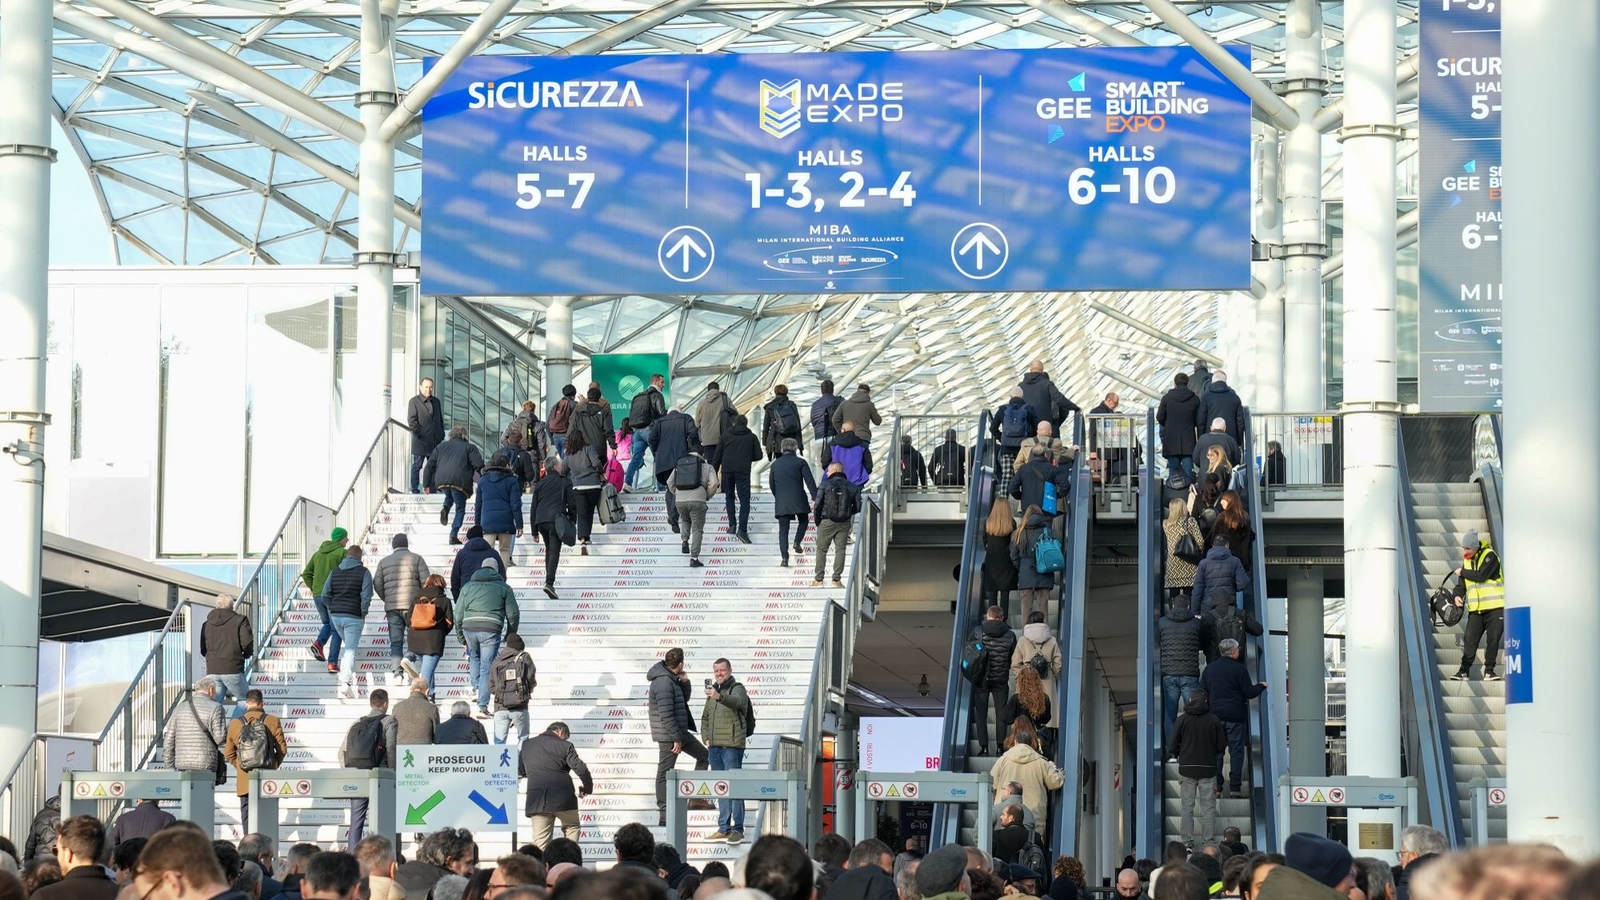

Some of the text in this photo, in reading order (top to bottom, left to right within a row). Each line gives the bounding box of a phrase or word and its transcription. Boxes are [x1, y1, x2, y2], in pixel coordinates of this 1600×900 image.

[1437, 57, 1502, 77] SiCUR
[468, 81, 644, 109] SiCUREZZA
[806, 84, 903, 102] MADE
[1105, 81, 1183, 98] SMART
[1475, 82, 1502, 93] HAL
[806, 104, 903, 122] EXPO
[1036, 97, 1092, 119] GEE
[1106, 98, 1209, 115] BUILDING
[1470, 95, 1502, 120] 5-
[1106, 115, 1166, 133] EXPO
[523, 145, 588, 161] HALLS
[798, 150, 863, 166] HALLS
[1089, 145, 1155, 162] HALLS
[515, 172, 596, 210] 5-7
[745, 171, 917, 213] 1-3, 2-4
[1068, 166, 1176, 206] 6-10
[1441, 176, 1480, 191] GEE
[1476, 211, 1502, 222] HAL
[809, 224, 852, 235] MIBA
[1511, 637, 1520, 649] by
[428, 756, 486, 764] PROSEGUI
[910, 822, 928, 830] 6-10
